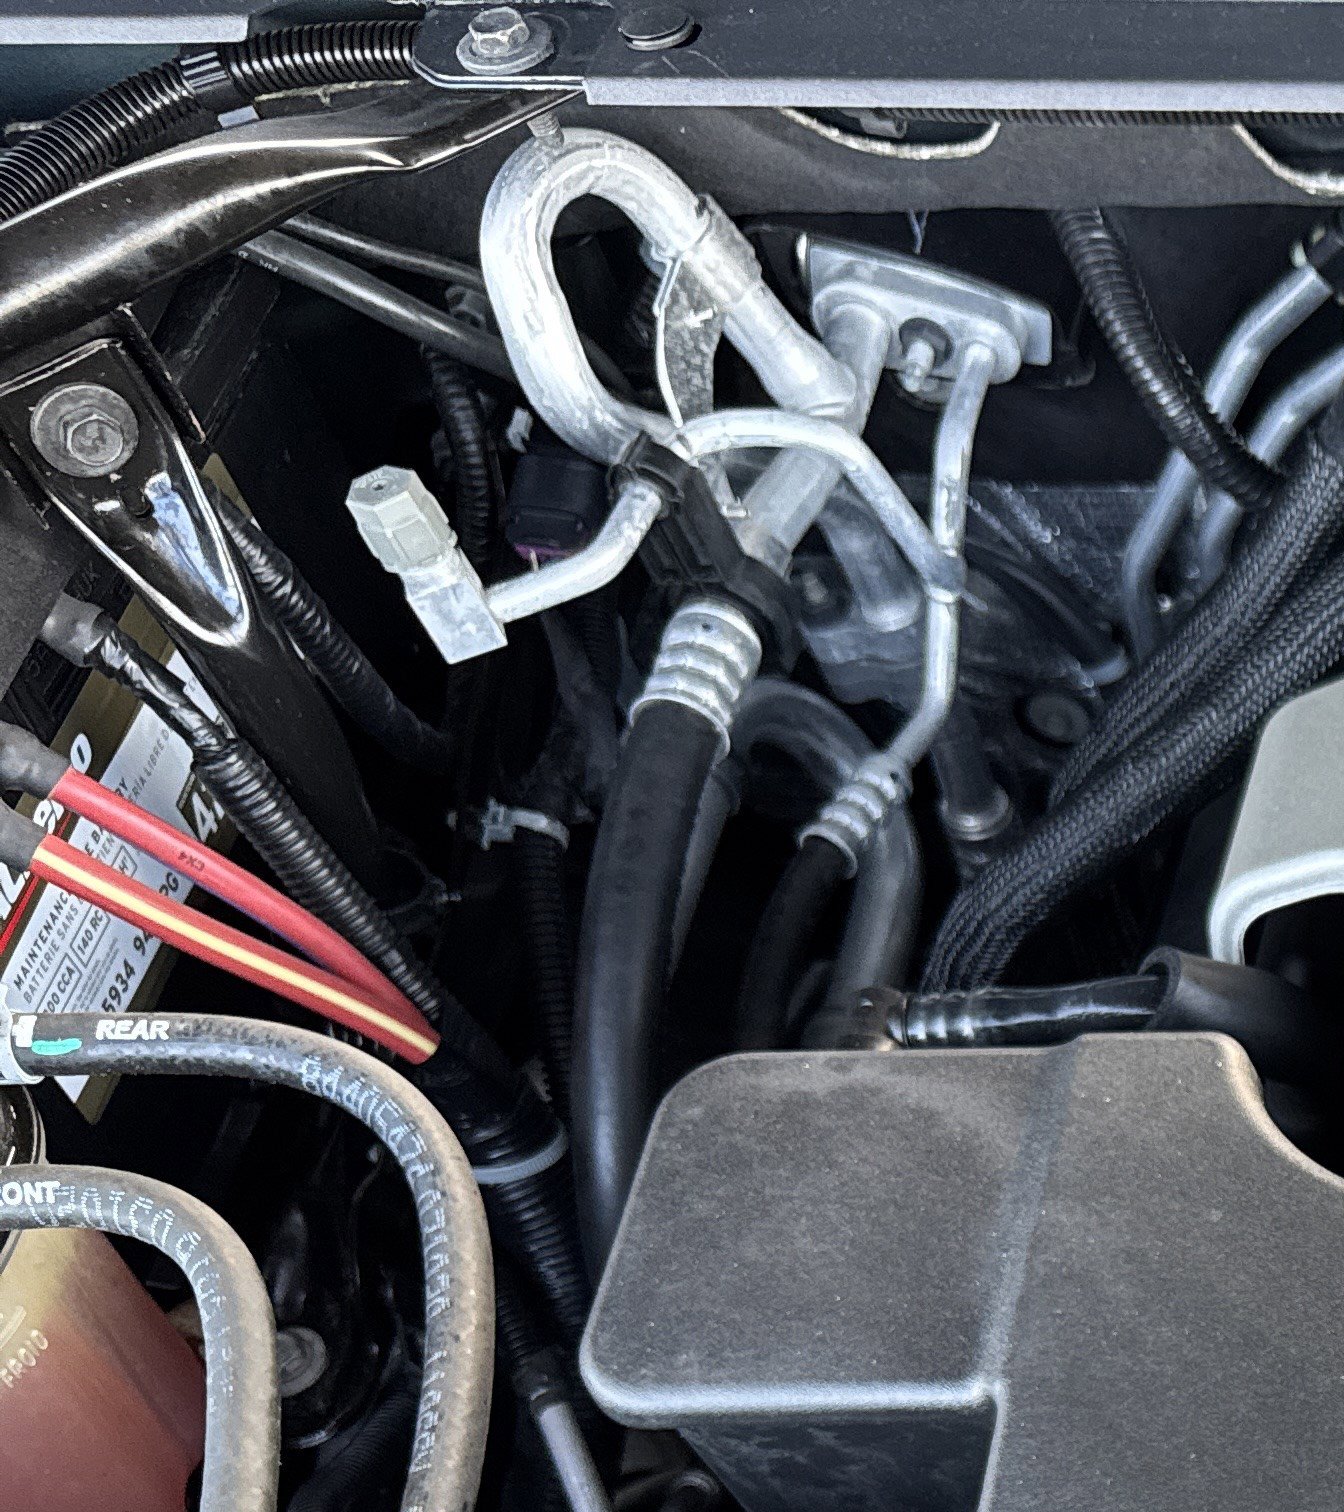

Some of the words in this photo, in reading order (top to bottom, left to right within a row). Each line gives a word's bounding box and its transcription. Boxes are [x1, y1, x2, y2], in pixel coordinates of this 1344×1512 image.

[23, 939, 59, 1003] BATTERIE
[57, 903, 78, 940] SANS
[77, 928, 93, 955] 140
[56, 965, 75, 993] CCA
[95, 1019, 169, 1040] REAR
[0, 1181, 61, 1206] ONT
